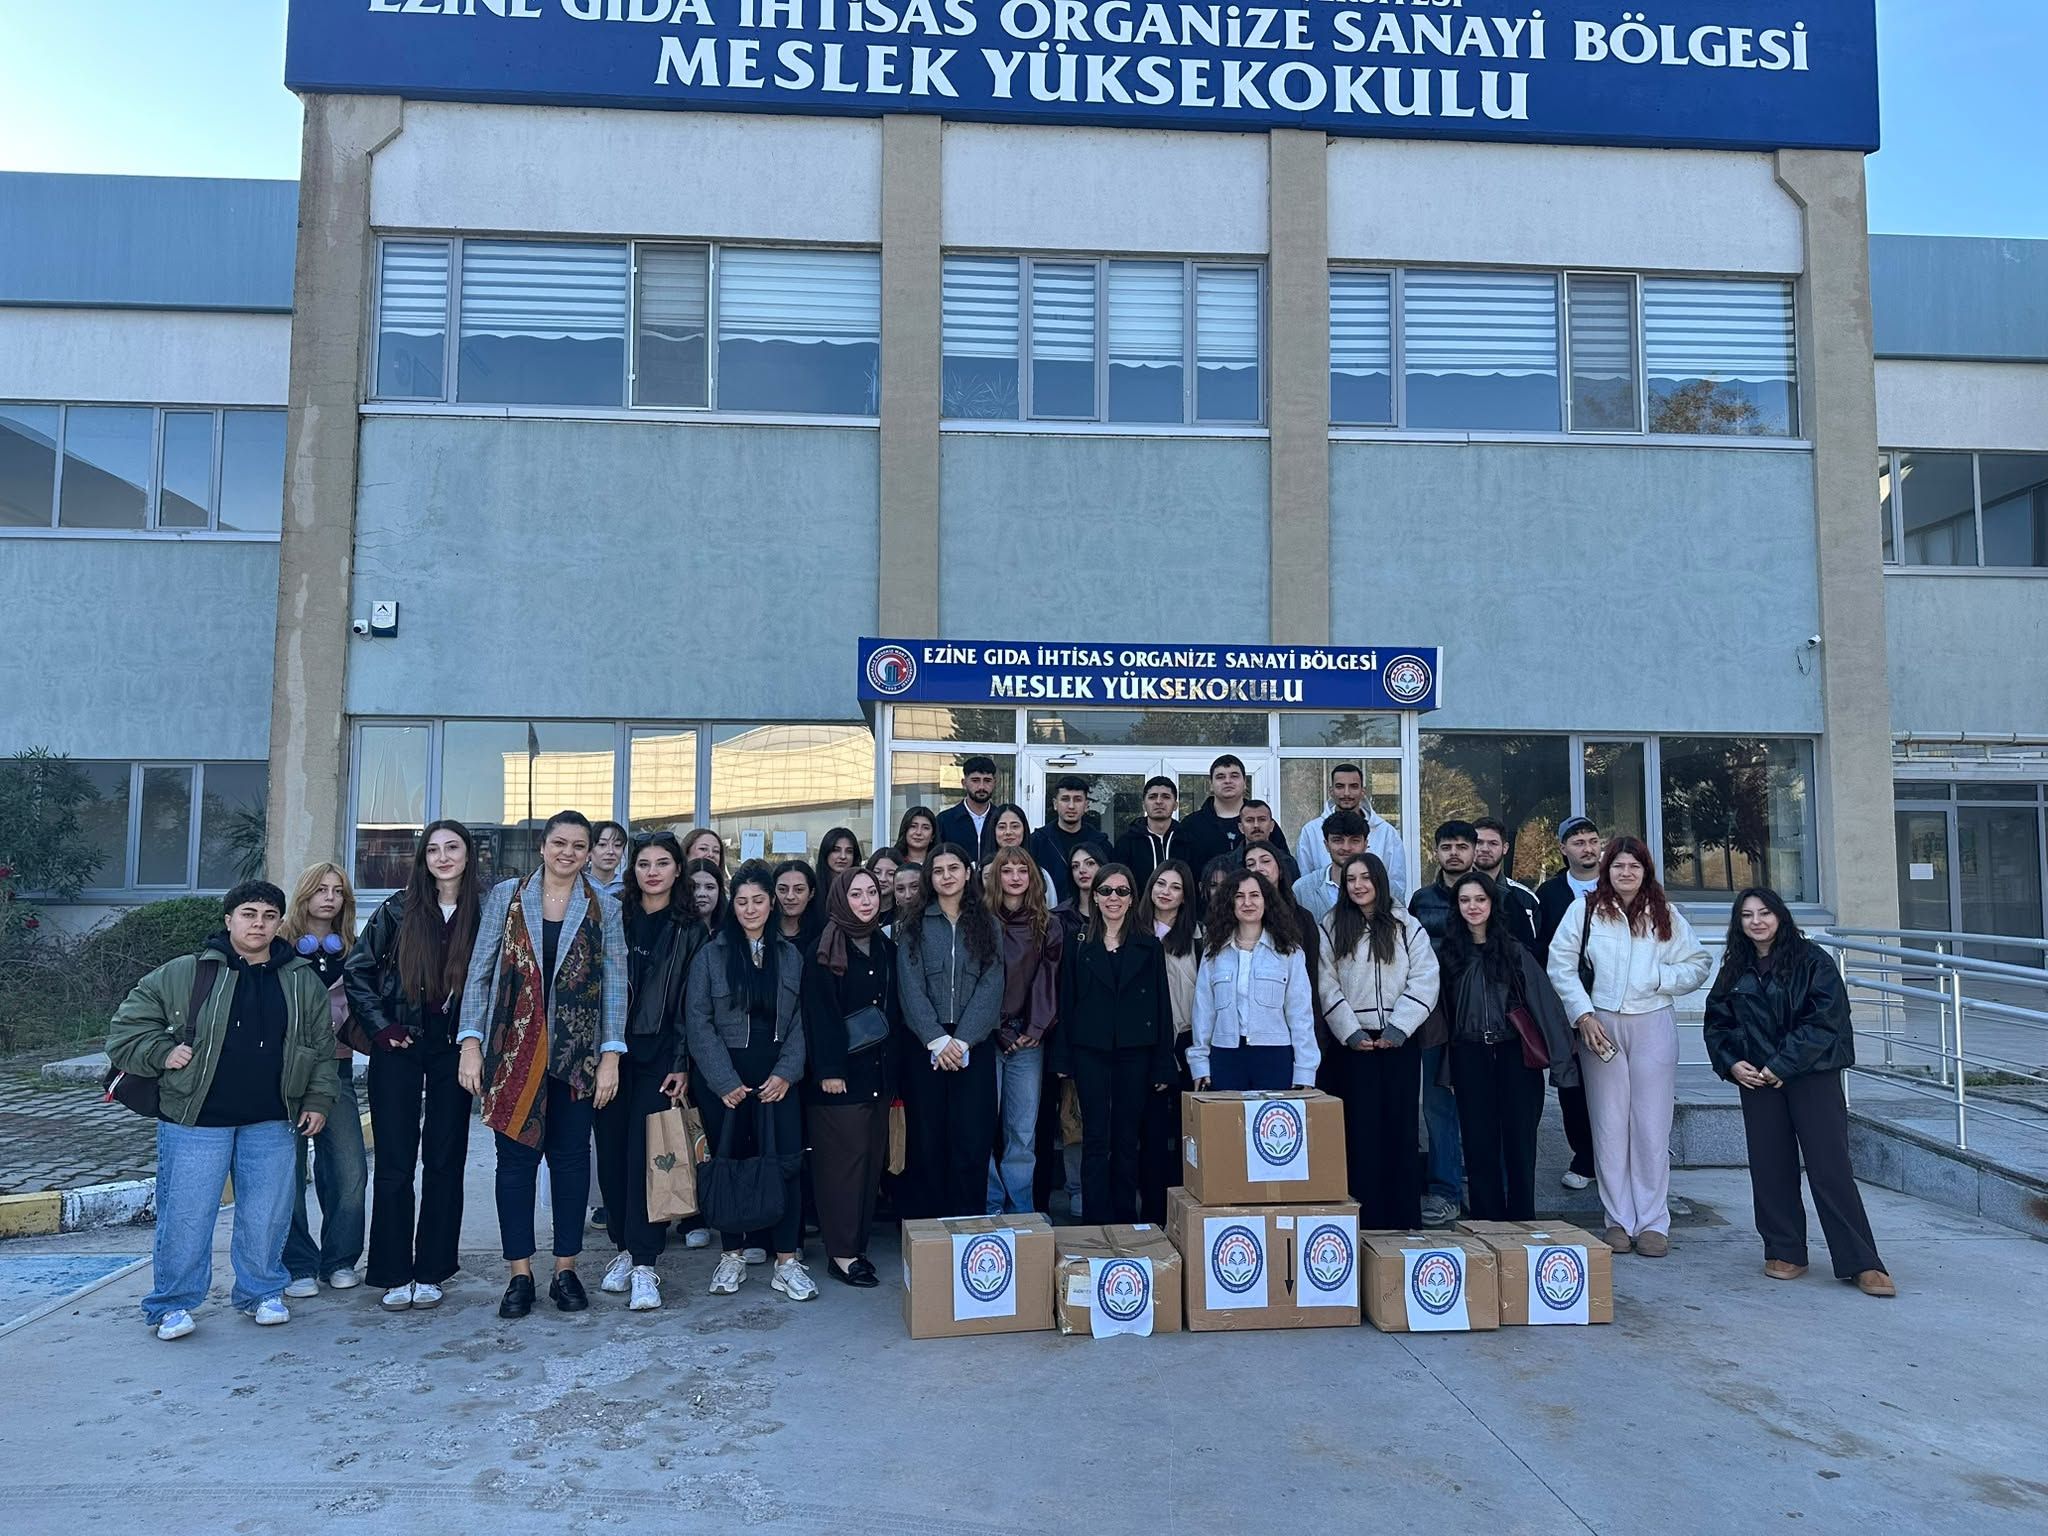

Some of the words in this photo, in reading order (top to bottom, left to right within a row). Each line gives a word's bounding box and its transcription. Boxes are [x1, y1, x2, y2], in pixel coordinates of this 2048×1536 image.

[999, 0, 1315, 51] ORGANİZE
[1332, 9, 1546, 60] SANAYİ
[1573, 12, 1810, 71] BÖLGESİ
[653, 36, 960, 98] MESLEK
[980, 41, 1529, 120] YÜKSEKOKULU
[923, 644, 978, 665] EZİNE
[983, 648, 1032, 666] GIDA
[1037, 645, 1114, 667] İHTİSAS
[1119, 648, 1217, 668] ORGANİZE
[1225, 649, 1296, 669] SANAYİ
[1300, 649, 1377, 671] BÖLGESİ
[989, 675, 1094, 699] MESLEK
[1101, 670, 1303, 703] YÜKSEKOKULU
